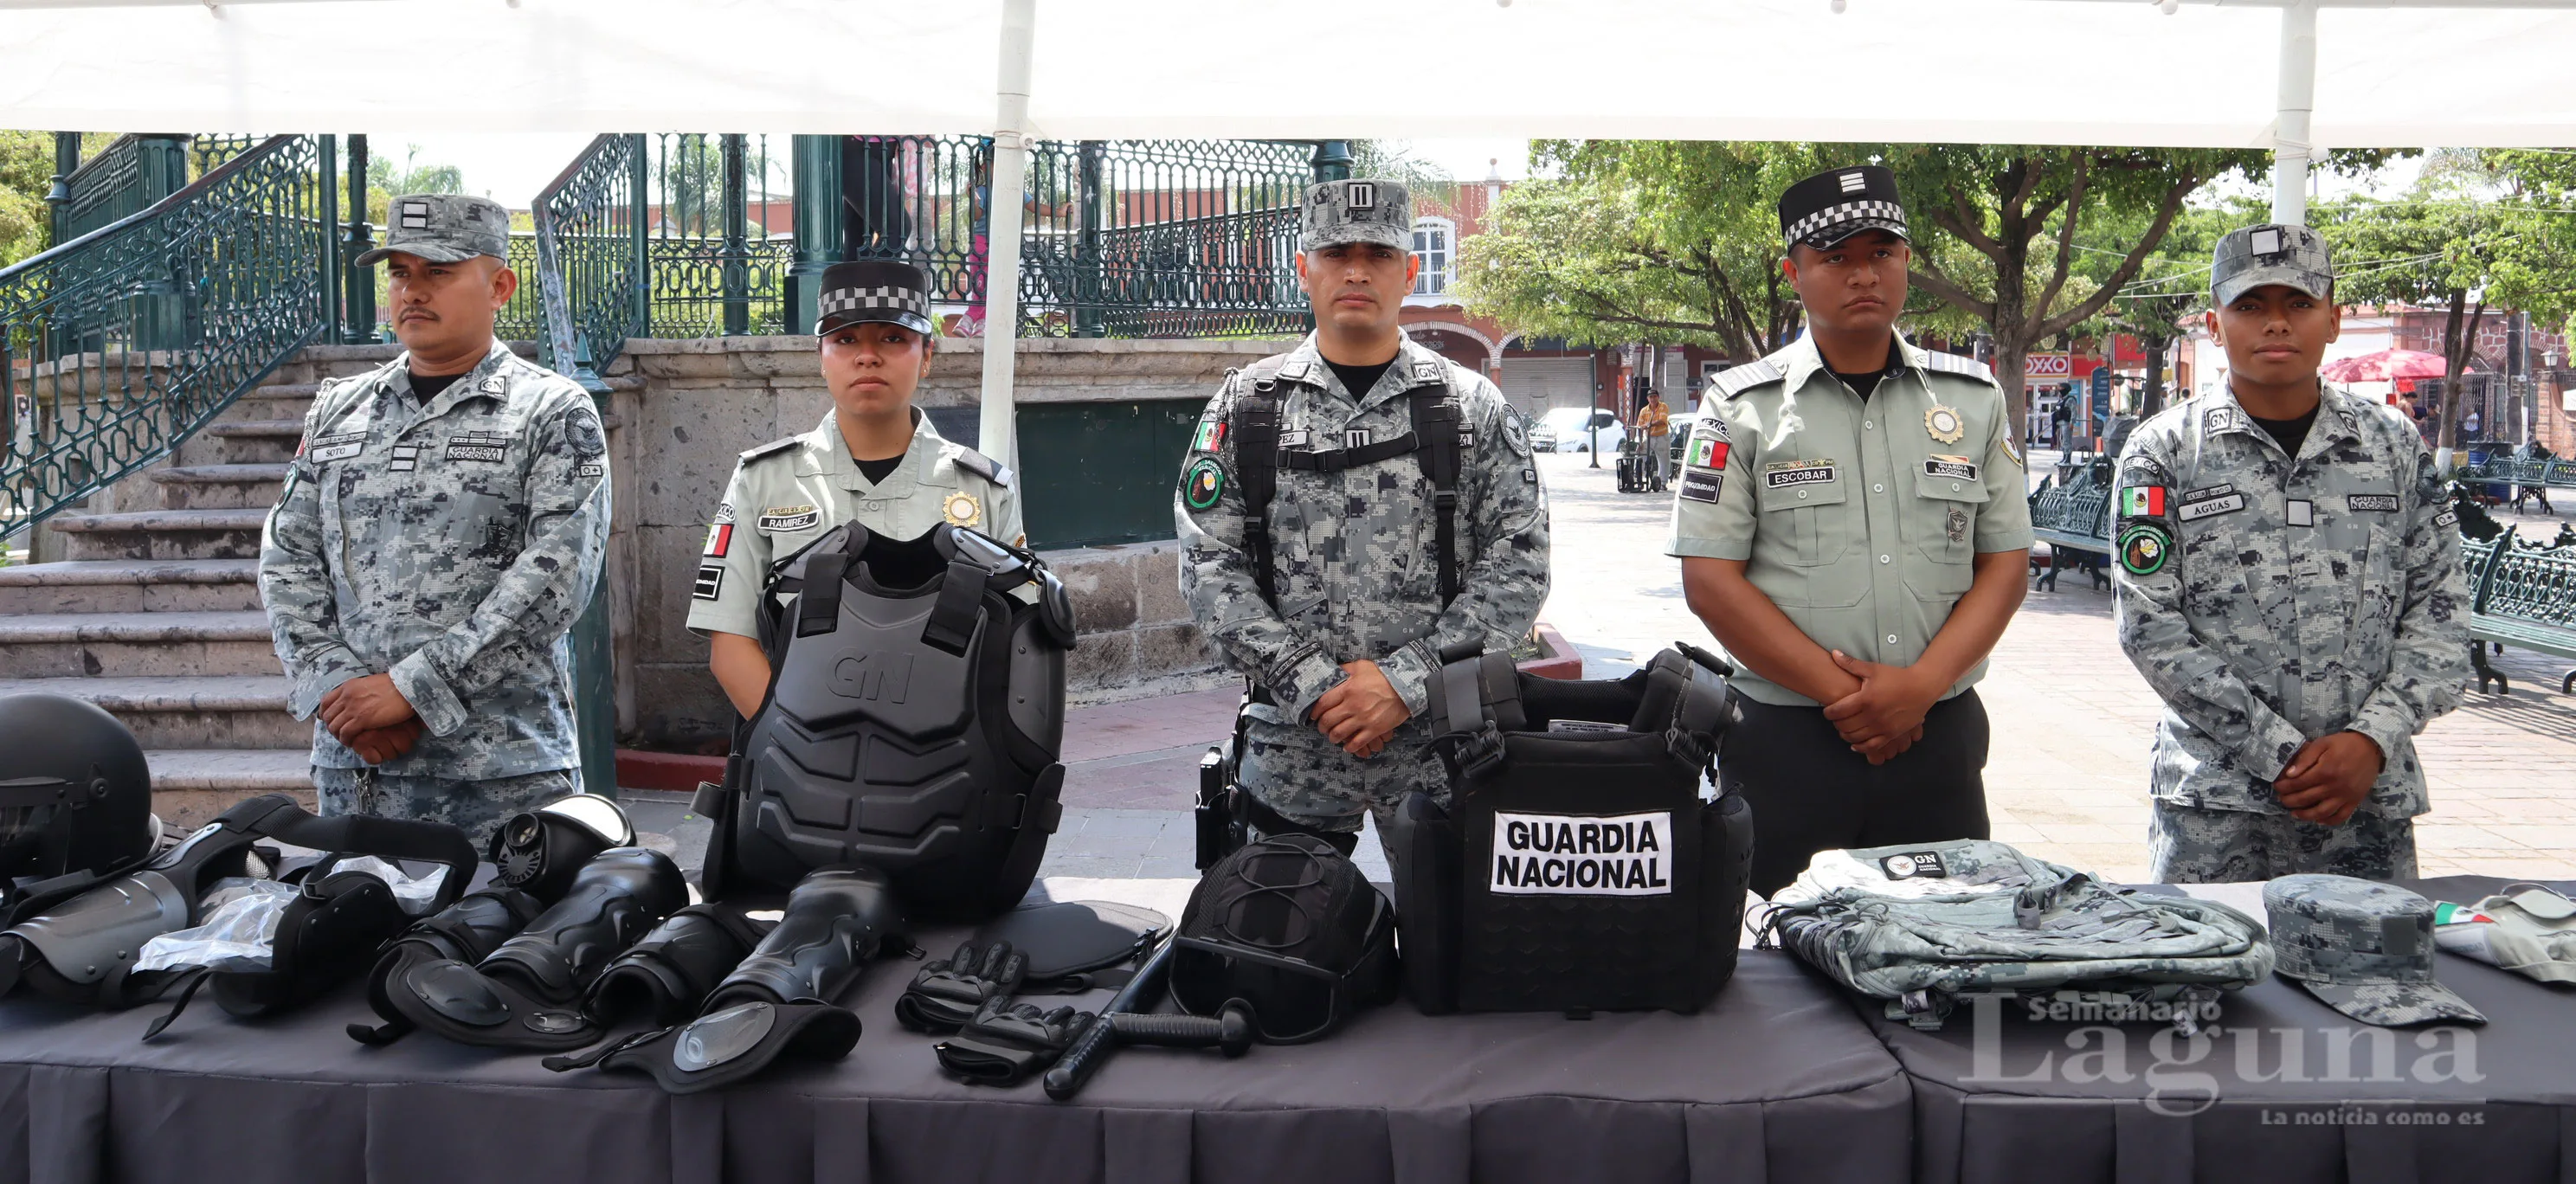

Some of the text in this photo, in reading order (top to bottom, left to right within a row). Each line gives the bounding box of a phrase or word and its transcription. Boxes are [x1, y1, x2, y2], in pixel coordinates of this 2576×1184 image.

[1417, 367, 1437, 377] GN
[481, 379, 504, 390] GN
[2209, 413, 2228, 428] GN
[325, 447, 345, 457] SOTO
[452, 446, 499, 454] GUARDIA
[448, 452, 500, 460] NACIONAL
[1935, 467, 1971, 478] NACIONAL
[1938, 463, 1968, 472] GUARDIA
[1774, 471, 1827, 484] ESCOBAR
[1685, 481, 1716, 492] PROXIMIDAD
[2194, 500, 2231, 515] AGUAS
[769, 516, 809, 528] RAMIREZ
[827, 647, 914, 705] GN
[1507, 820, 1659, 854] GUARDIA
[1915, 854, 1936, 864] GN
[1497, 855, 1667, 889] NACIONAL
